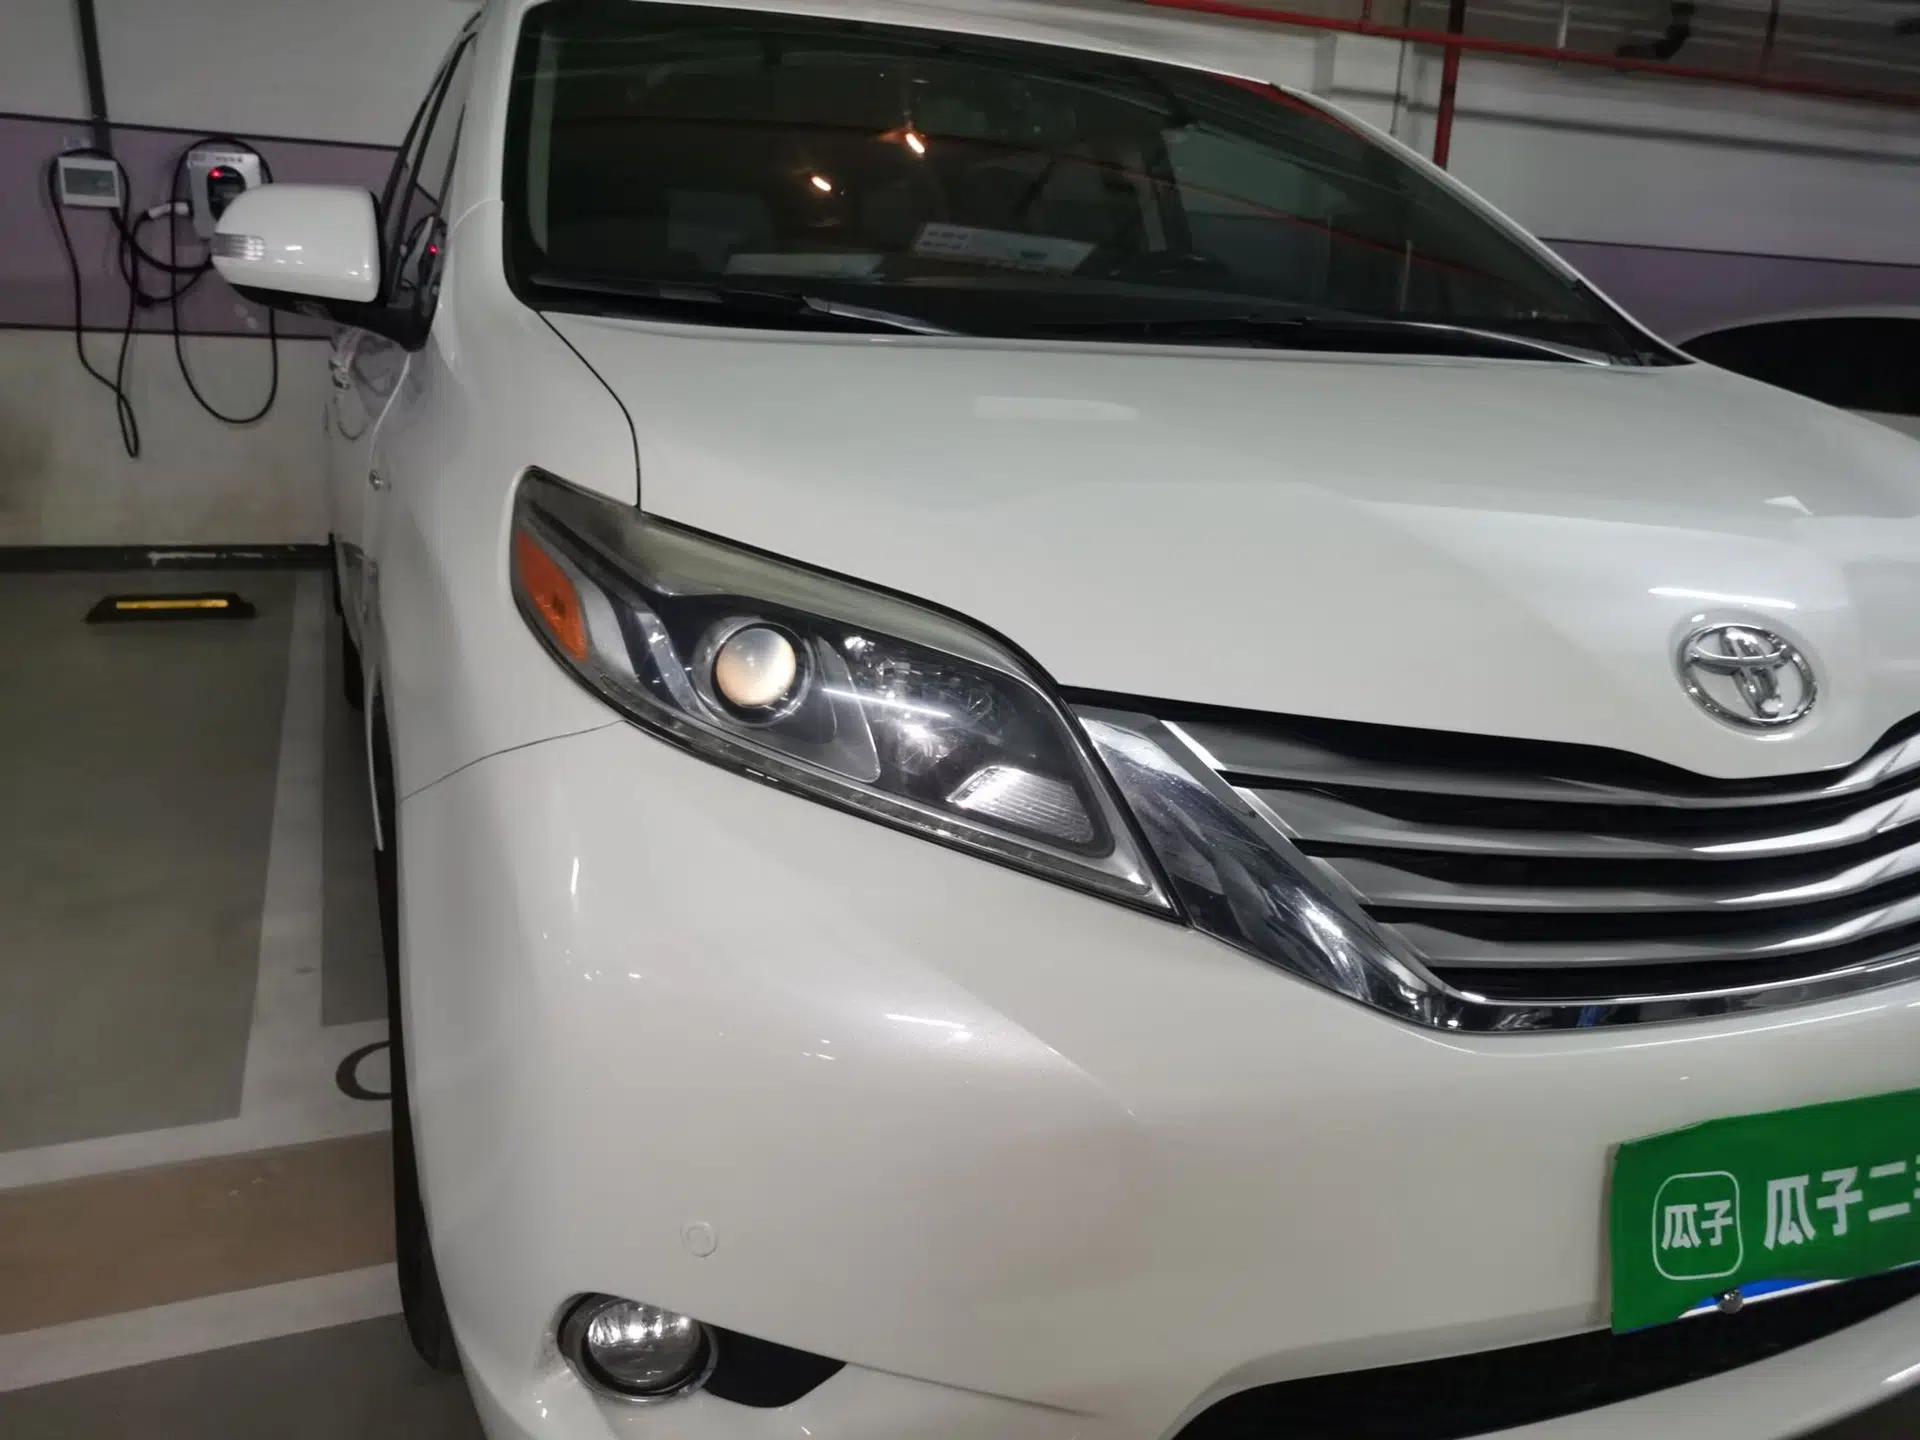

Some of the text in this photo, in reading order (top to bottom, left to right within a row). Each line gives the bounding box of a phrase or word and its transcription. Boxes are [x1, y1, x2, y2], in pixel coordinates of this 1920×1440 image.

[1661, 1200, 1733, 1250] 瓜子
[1764, 1155, 1920, 1250] 瓜子二
